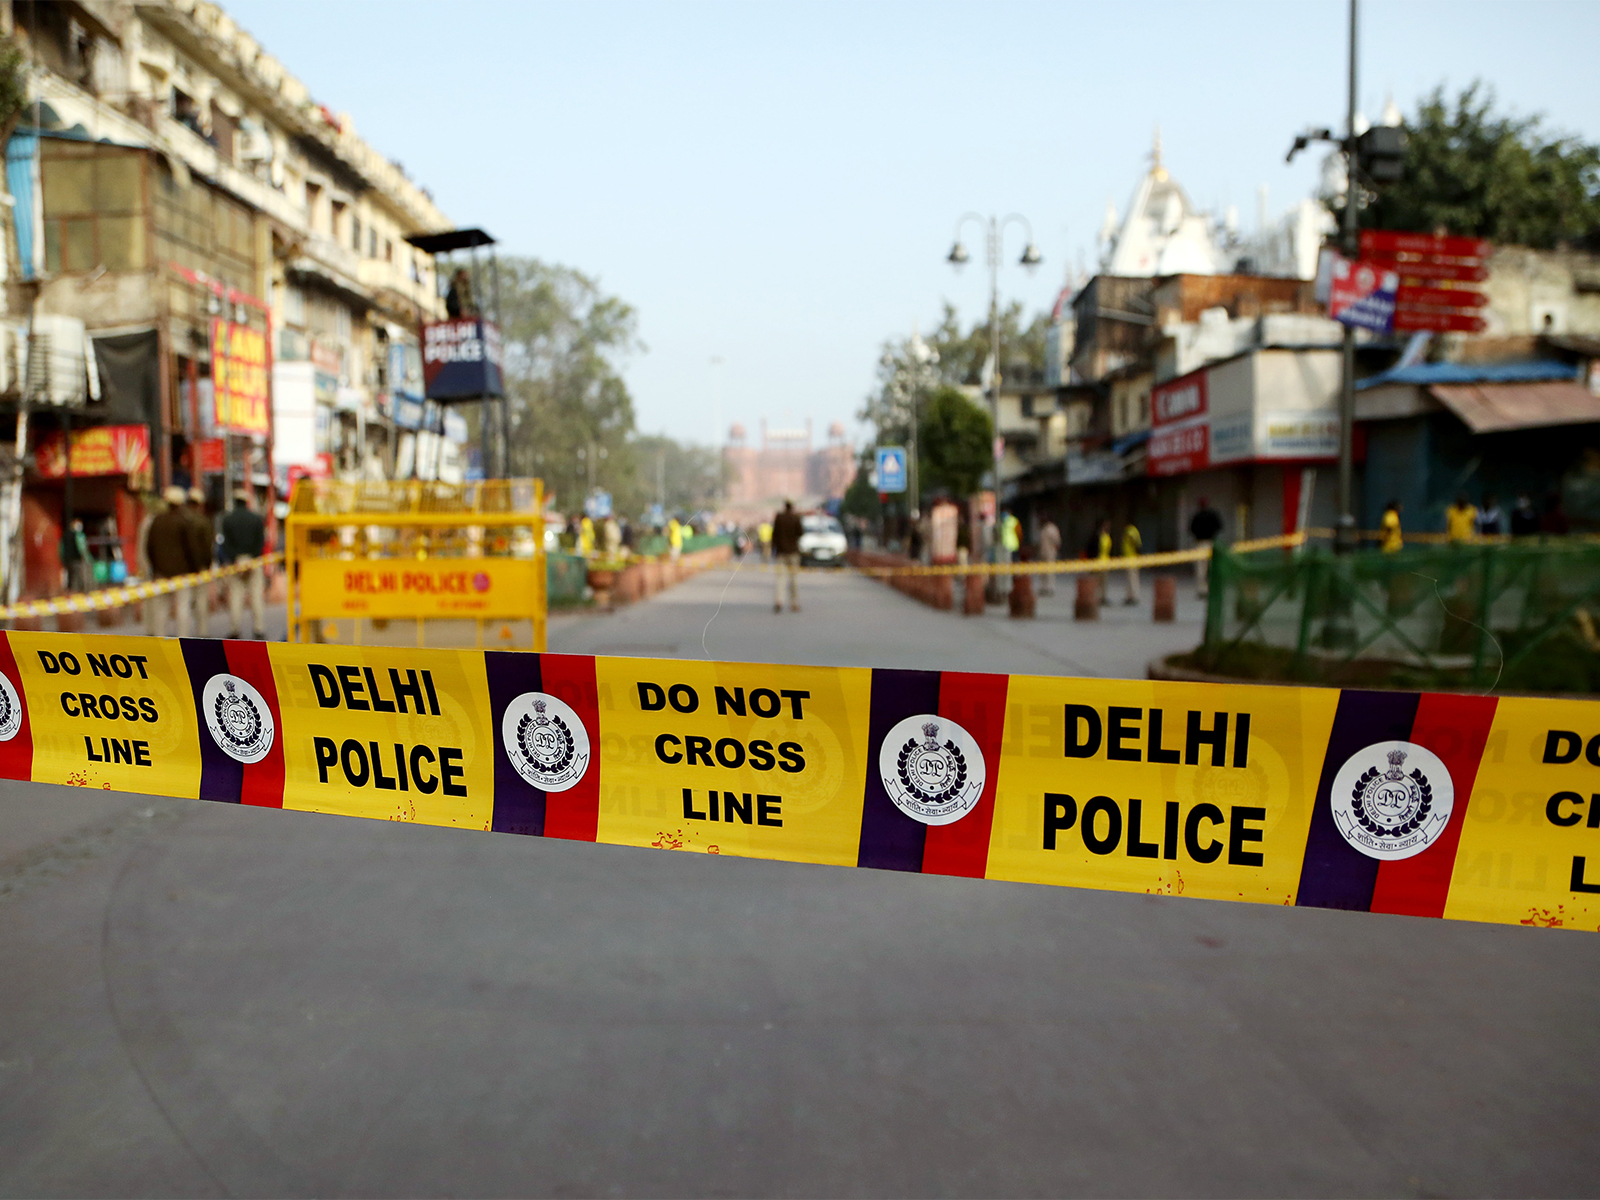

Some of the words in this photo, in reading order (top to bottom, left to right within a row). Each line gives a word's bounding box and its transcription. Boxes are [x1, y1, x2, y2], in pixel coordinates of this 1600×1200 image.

[425, 341, 481, 364] POLICE
[344, 571, 397, 593] DELHI
[402, 571, 470, 594] POLICE
[37, 651, 80, 675] DO
[86, 654, 148, 679] NOT
[308, 664, 440, 715] DELHI
[637, 682, 698, 713] DO
[715, 687, 810, 719] NOT
[61, 692, 158, 722] CROSS
[85, 736, 151, 766] LINE
[1065, 704, 1250, 768] DELHI
[314, 737, 467, 797] POLICE
[655, 734, 805, 772] CROSS
[1366, 777, 1384, 799] POLICE
[683, 789, 782, 827] LINE
[1366, 800, 1380, 820] DELHI
[1044, 793, 1265, 866] POLICE
